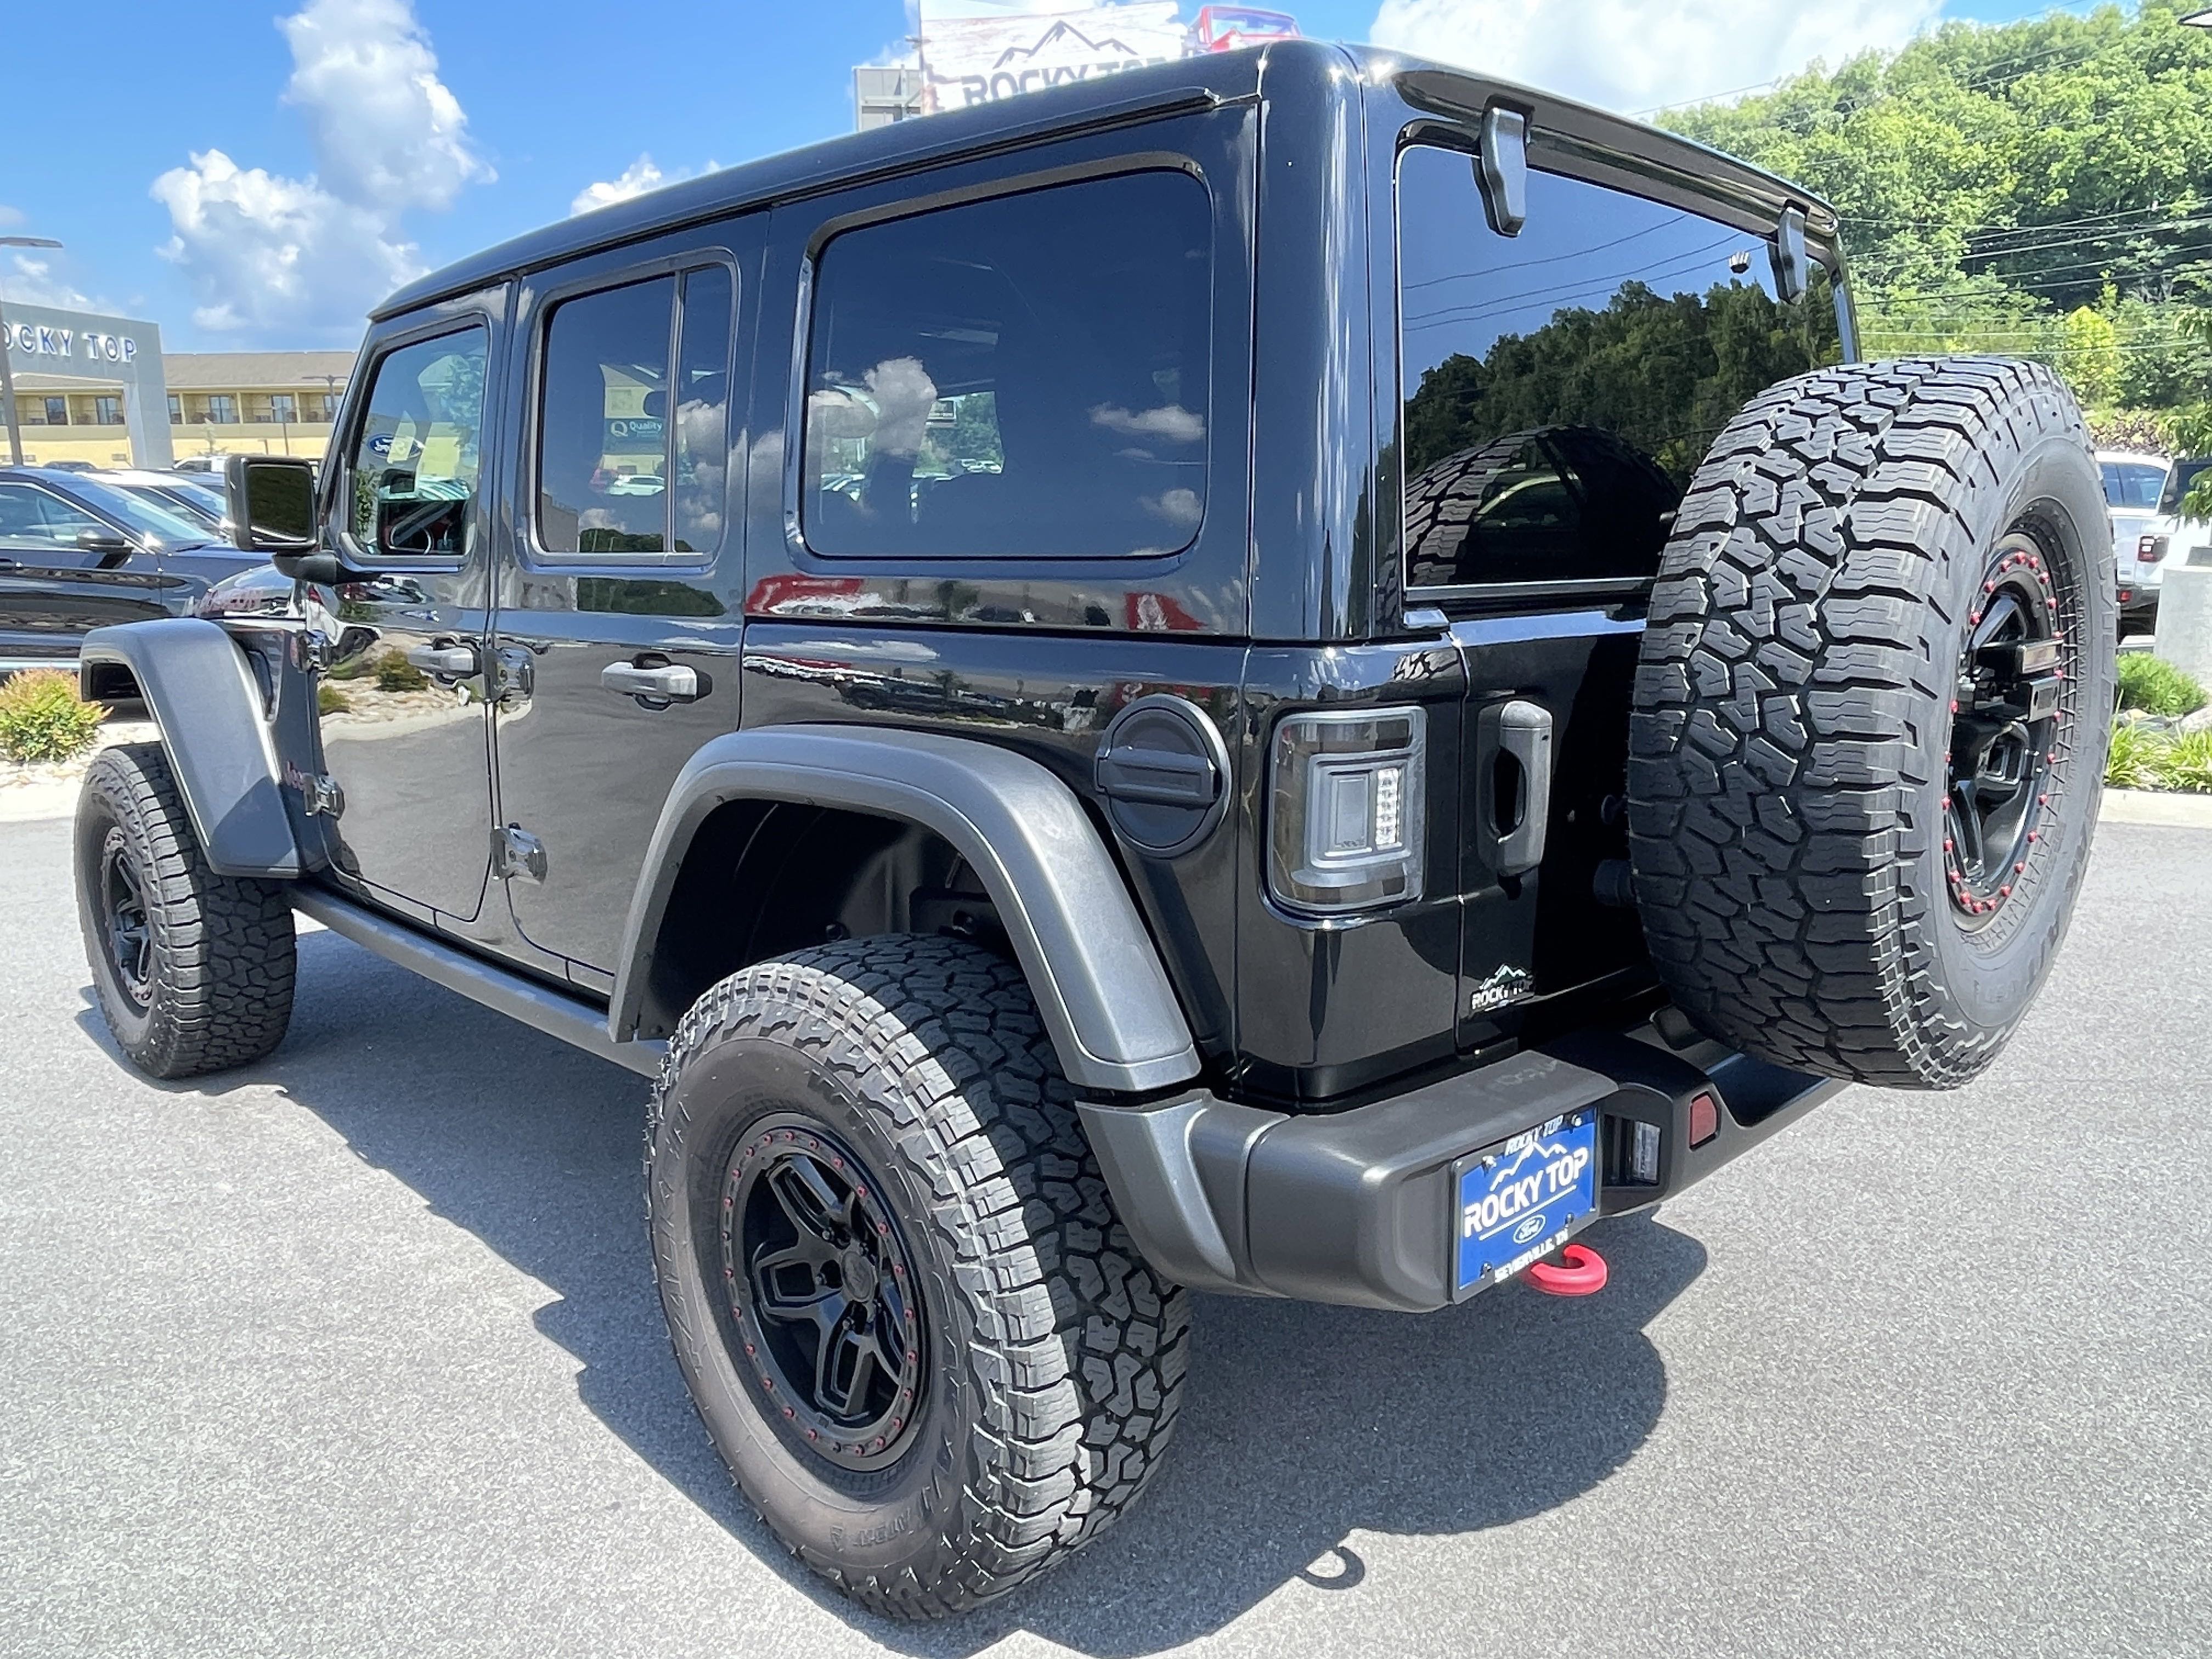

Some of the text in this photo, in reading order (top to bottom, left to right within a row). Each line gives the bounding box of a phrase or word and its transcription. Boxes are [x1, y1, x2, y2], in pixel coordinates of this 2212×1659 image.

[82, 332, 137, 363] TOP
[1504, 1115, 1564, 1156] ROCKY TOP
[1464, 1147, 1589, 1238] ROCKY TOP
